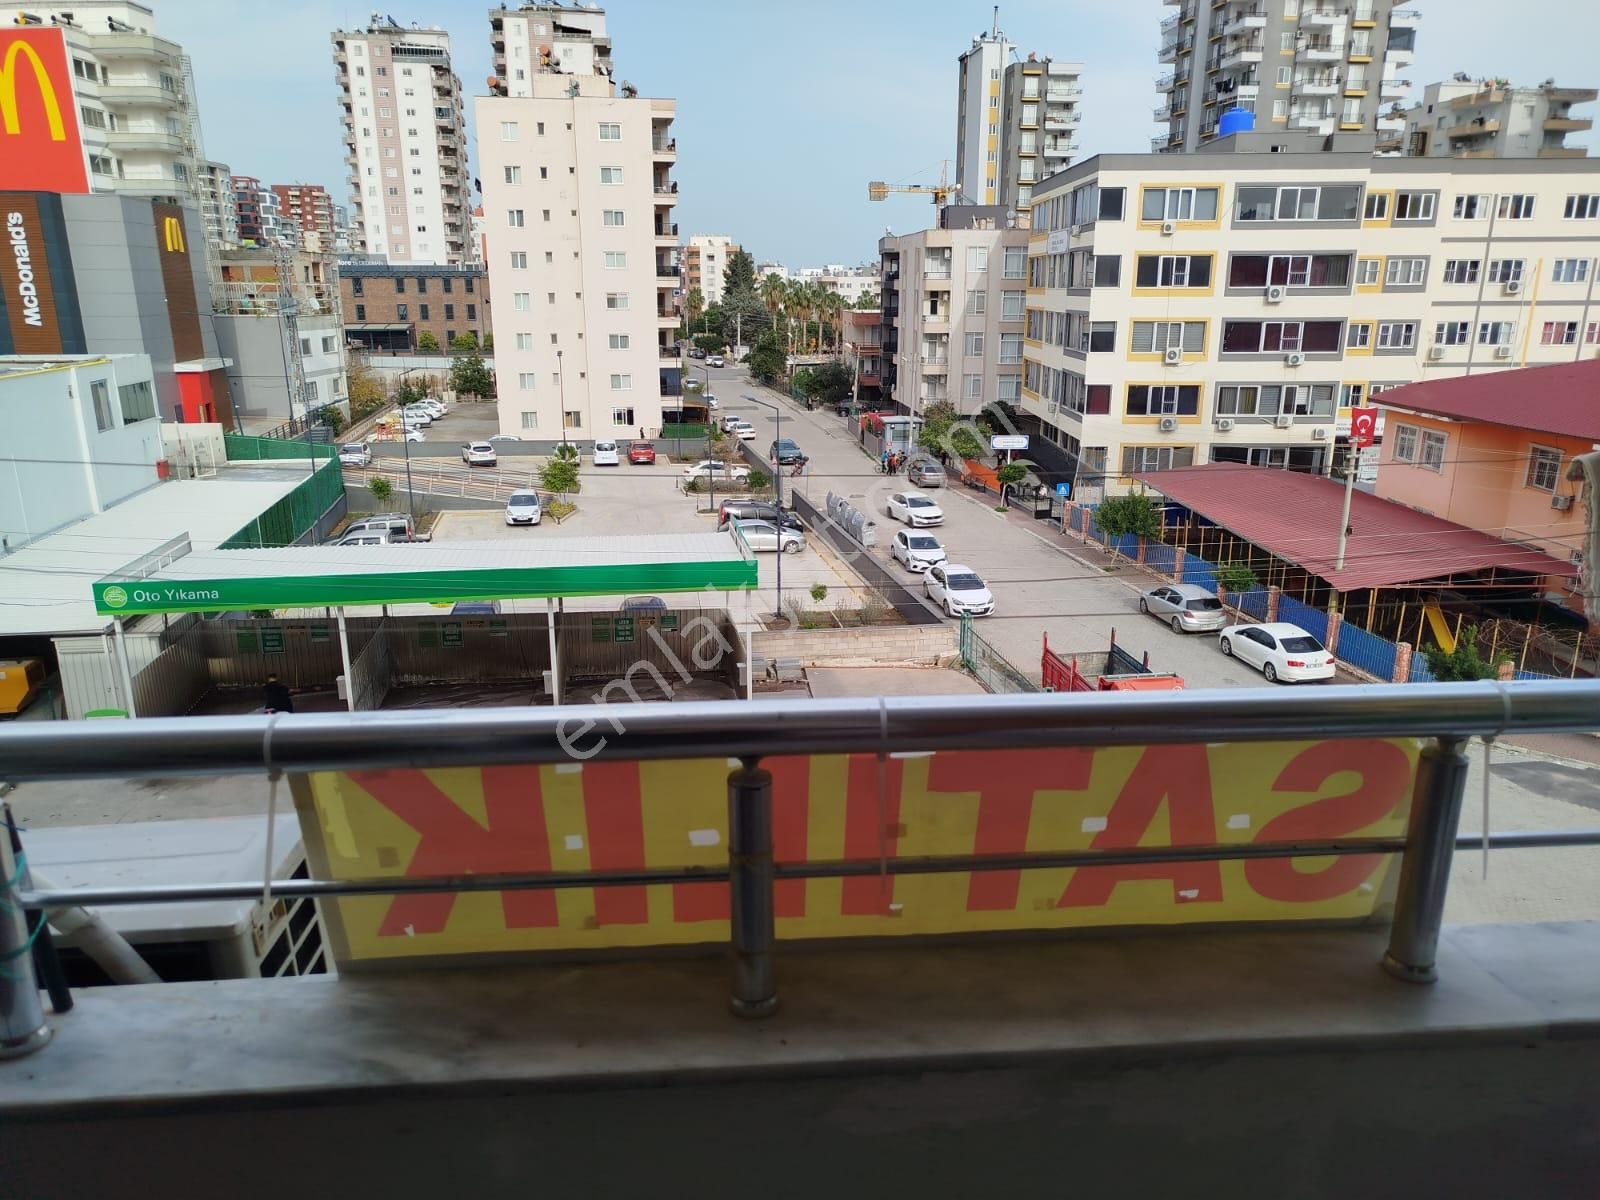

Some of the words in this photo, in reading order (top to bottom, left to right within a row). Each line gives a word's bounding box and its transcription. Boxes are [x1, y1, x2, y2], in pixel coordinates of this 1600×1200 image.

[6, 211, 43, 327] McDonald's
[133, 590, 161, 602] Oto
[164, 588, 220, 601] Yıkama
